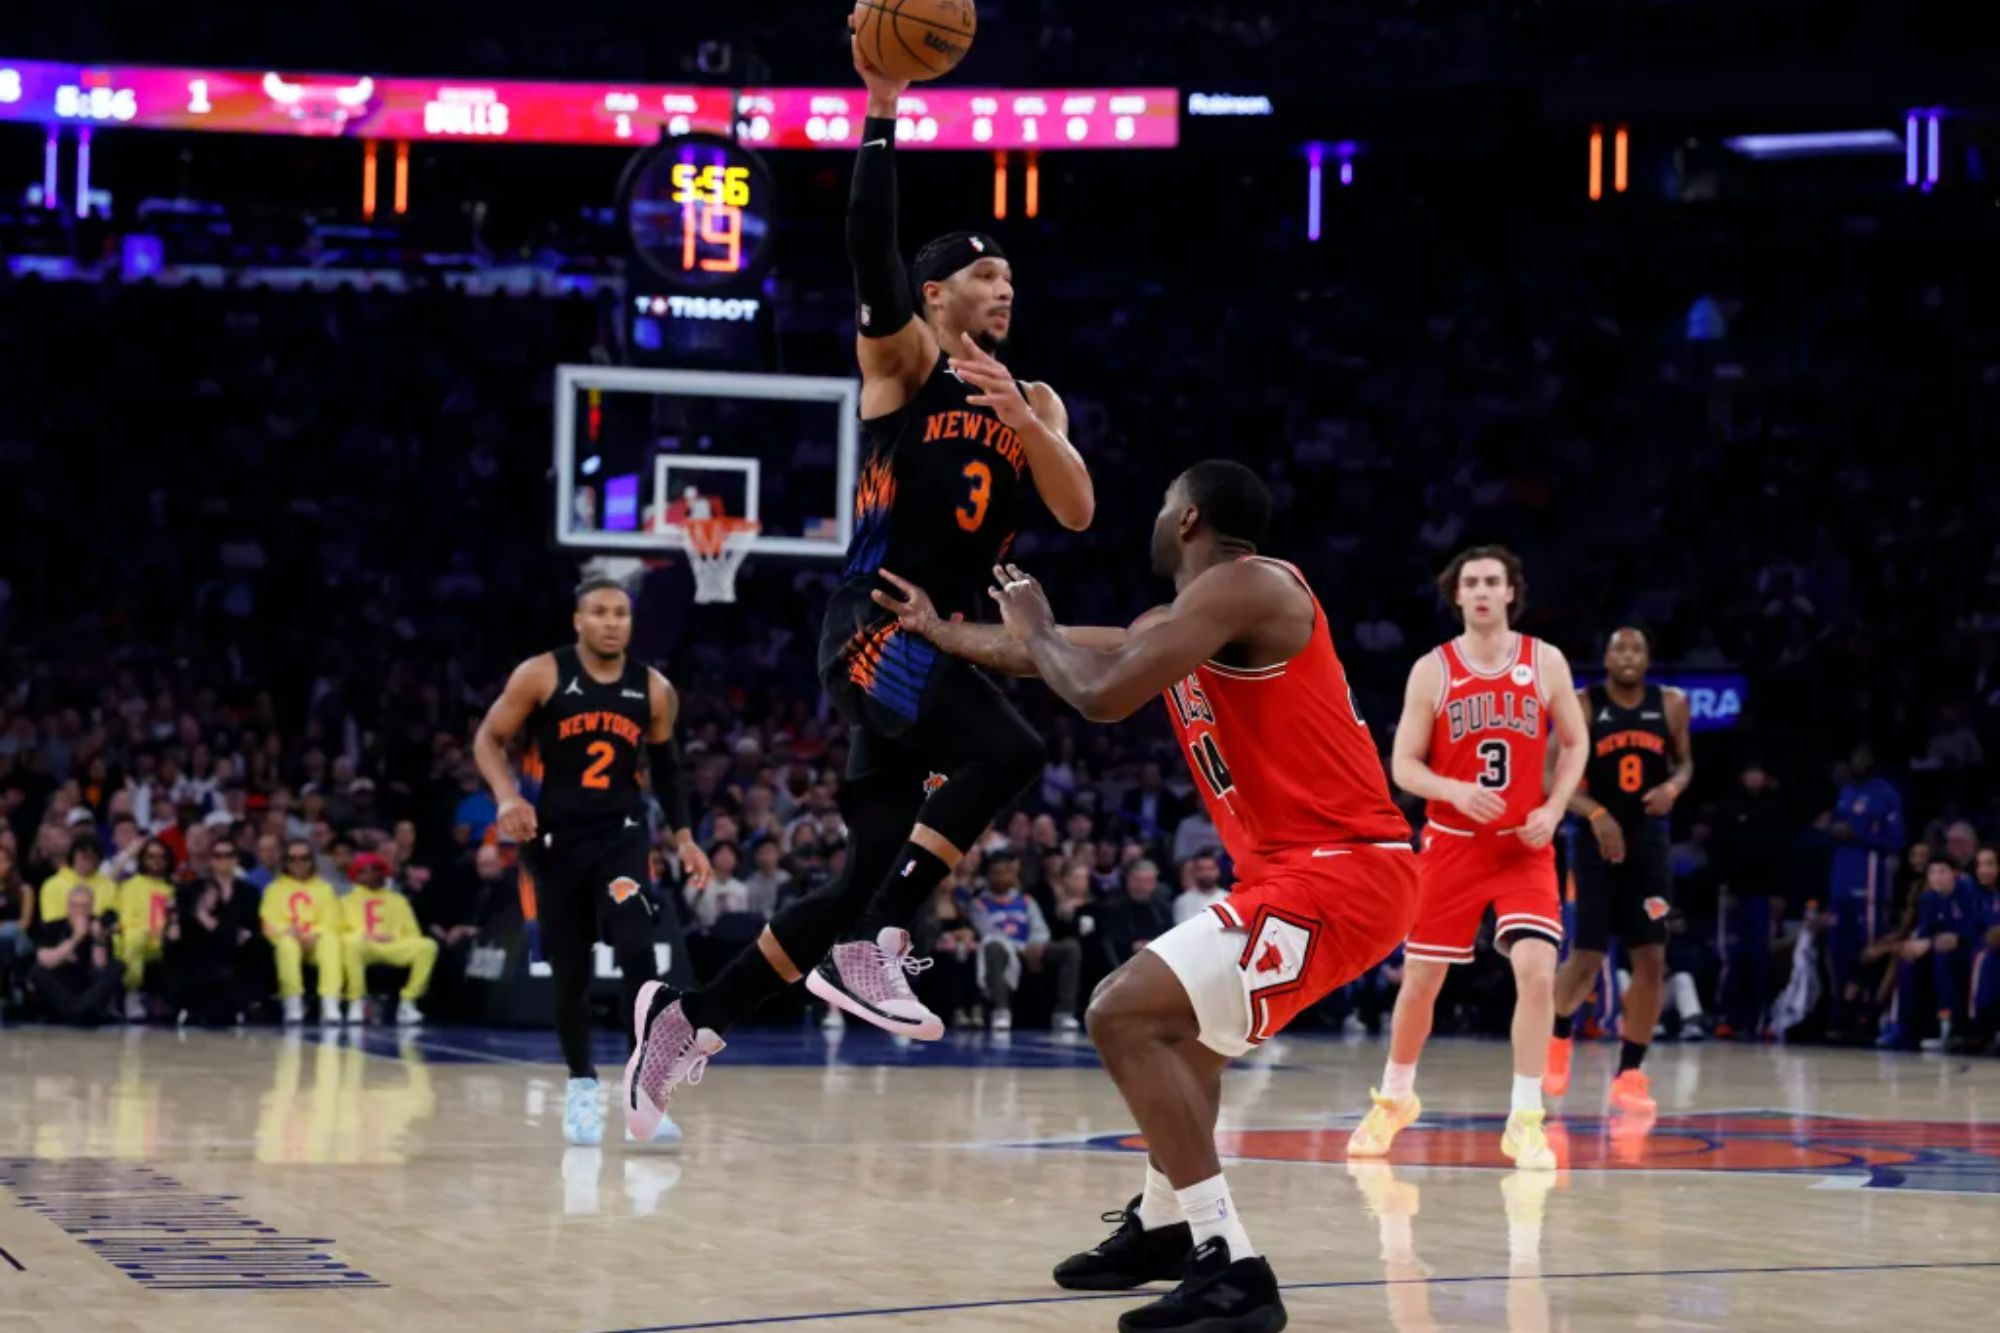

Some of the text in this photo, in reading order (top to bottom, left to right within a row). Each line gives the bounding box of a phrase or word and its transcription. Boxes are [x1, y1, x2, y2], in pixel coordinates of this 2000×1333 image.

[424, 101, 509, 135] BULLS
[671, 163, 750, 206] 5:56
[682, 204, 742, 271] 19
[955, 460, 993, 533] 3
[1447, 690, 1540, 743] BULLS
[581, 740, 615, 789] 2
[1477, 738, 1511, 791] 3
[1618, 753, 1643, 793] 8
[288, 891, 313, 934] C
[364, 899, 391, 942] E
